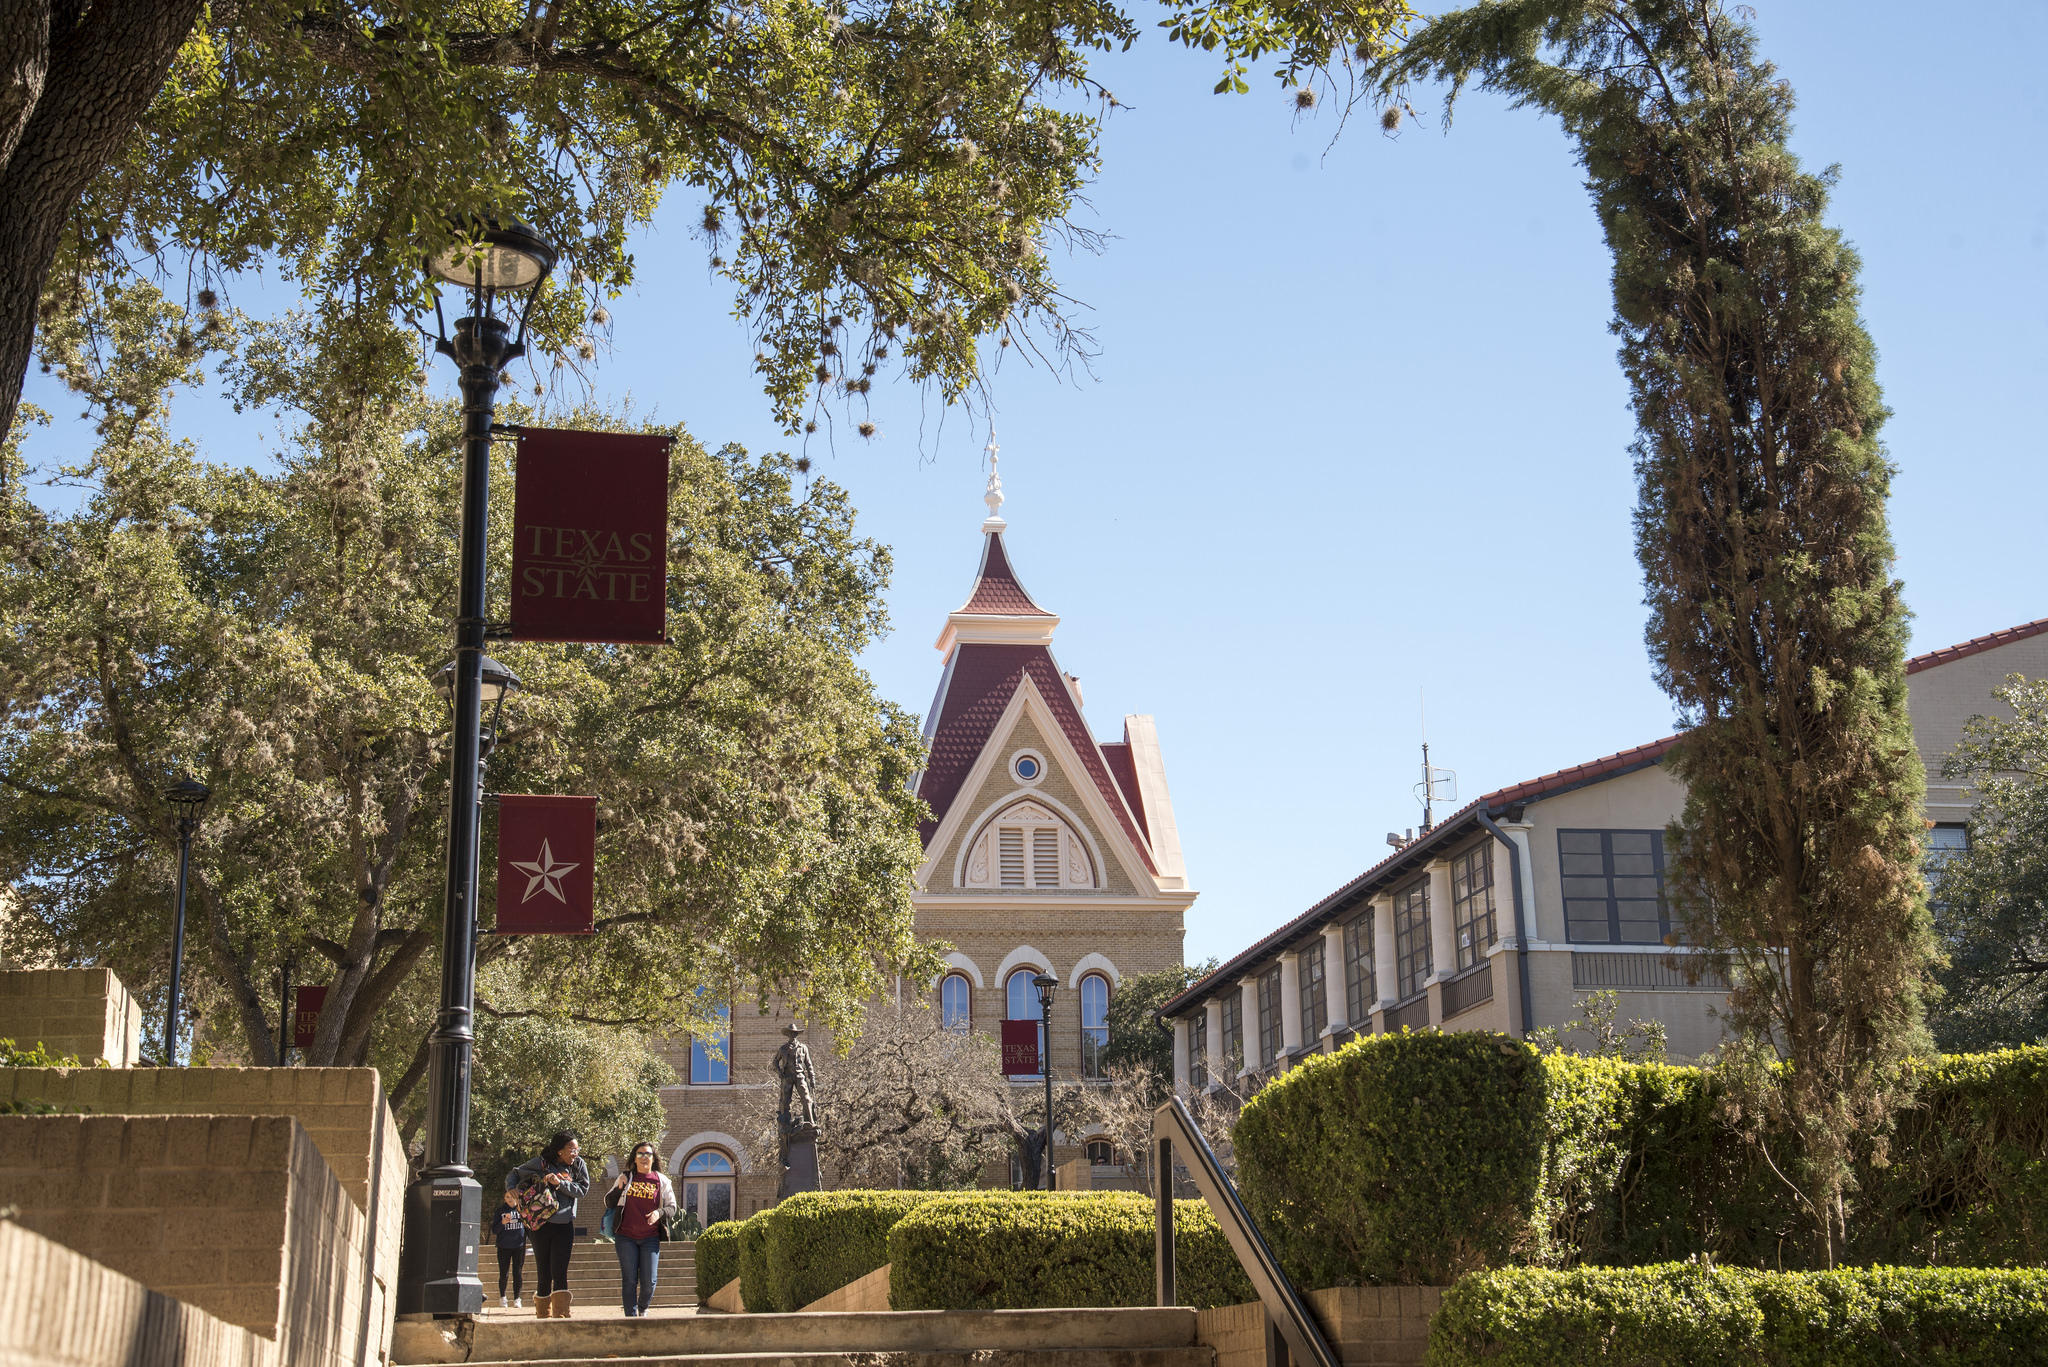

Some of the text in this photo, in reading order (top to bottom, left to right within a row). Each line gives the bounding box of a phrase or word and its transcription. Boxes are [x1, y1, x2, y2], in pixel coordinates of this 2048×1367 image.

[524, 525, 653, 562] TEXAS
[521, 567, 650, 602] STATE
[1005, 1044, 1035, 1053] TEXAS
[1005, 1055, 1035, 1064] STATE
